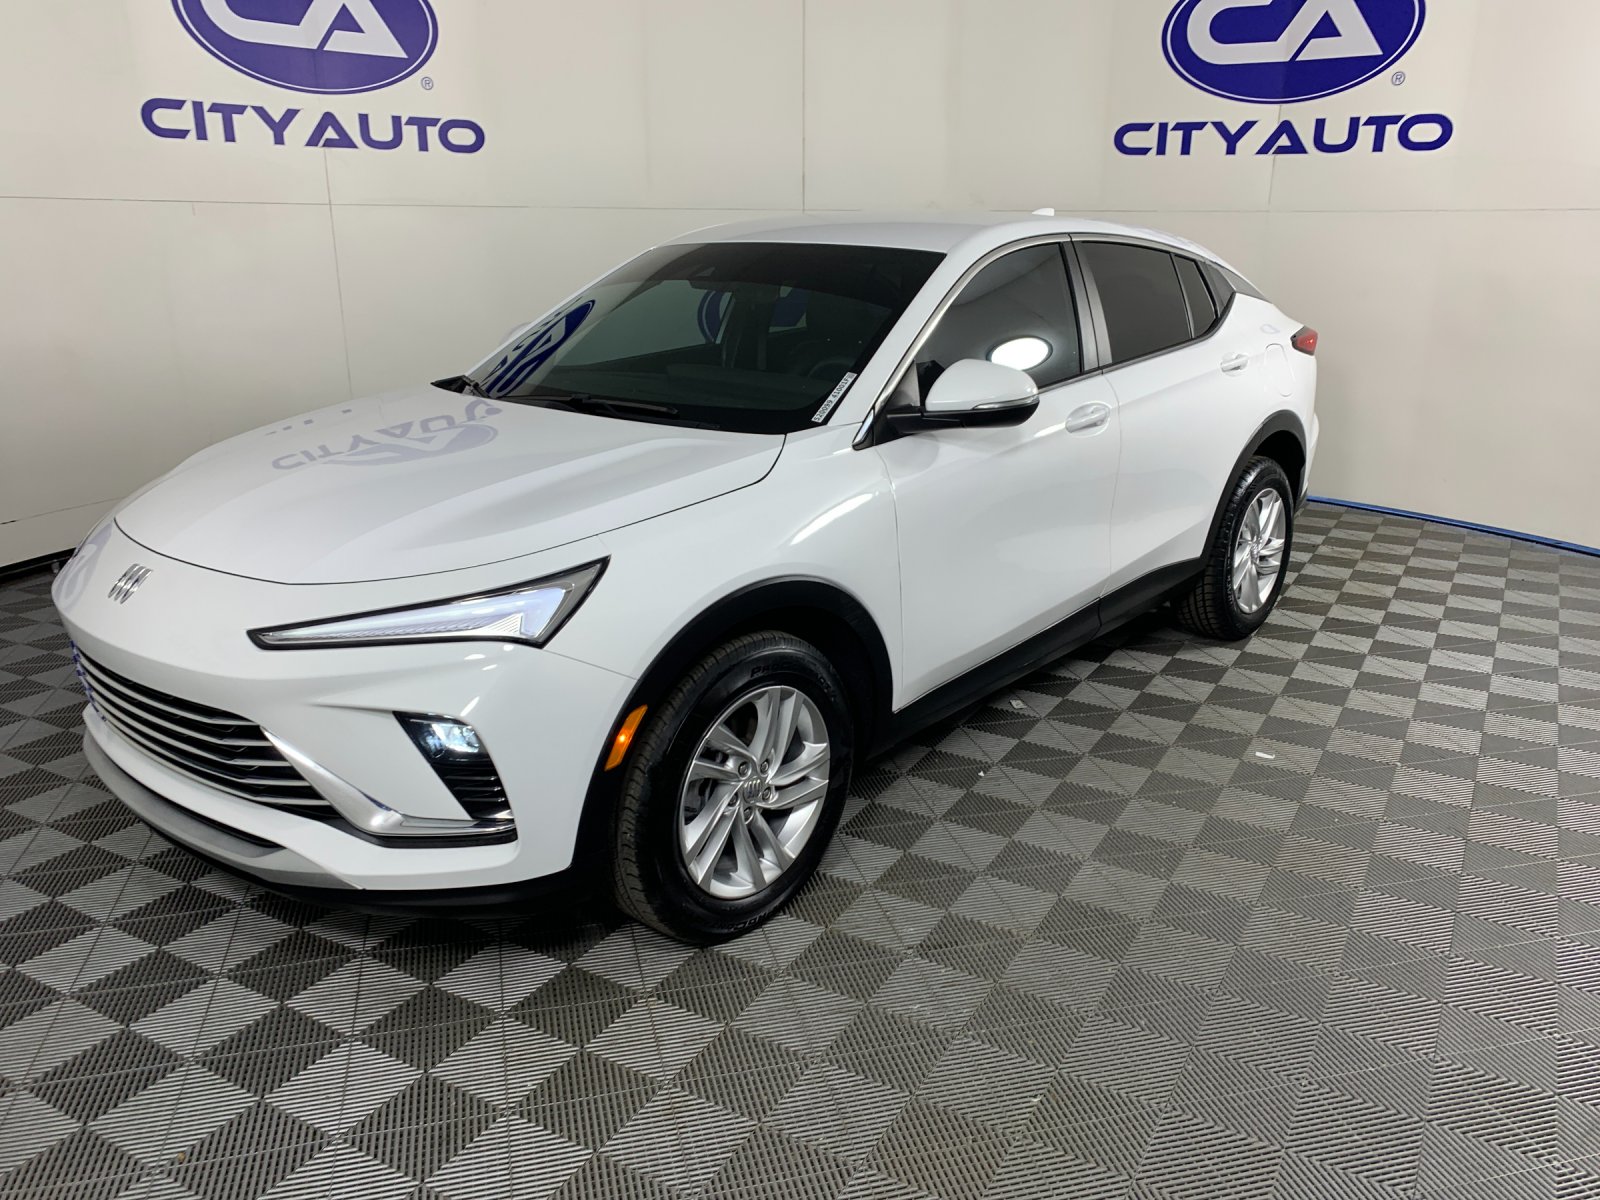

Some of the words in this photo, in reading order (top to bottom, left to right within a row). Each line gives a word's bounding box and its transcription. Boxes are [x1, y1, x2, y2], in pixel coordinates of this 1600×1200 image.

[1186, 0, 1384, 65] CA
[140, 98, 302, 146] CITY
[304, 111, 486, 154] AUTO
[1113, 120, 1259, 156] CITY
[1254, 113, 1454, 156] AUTO
